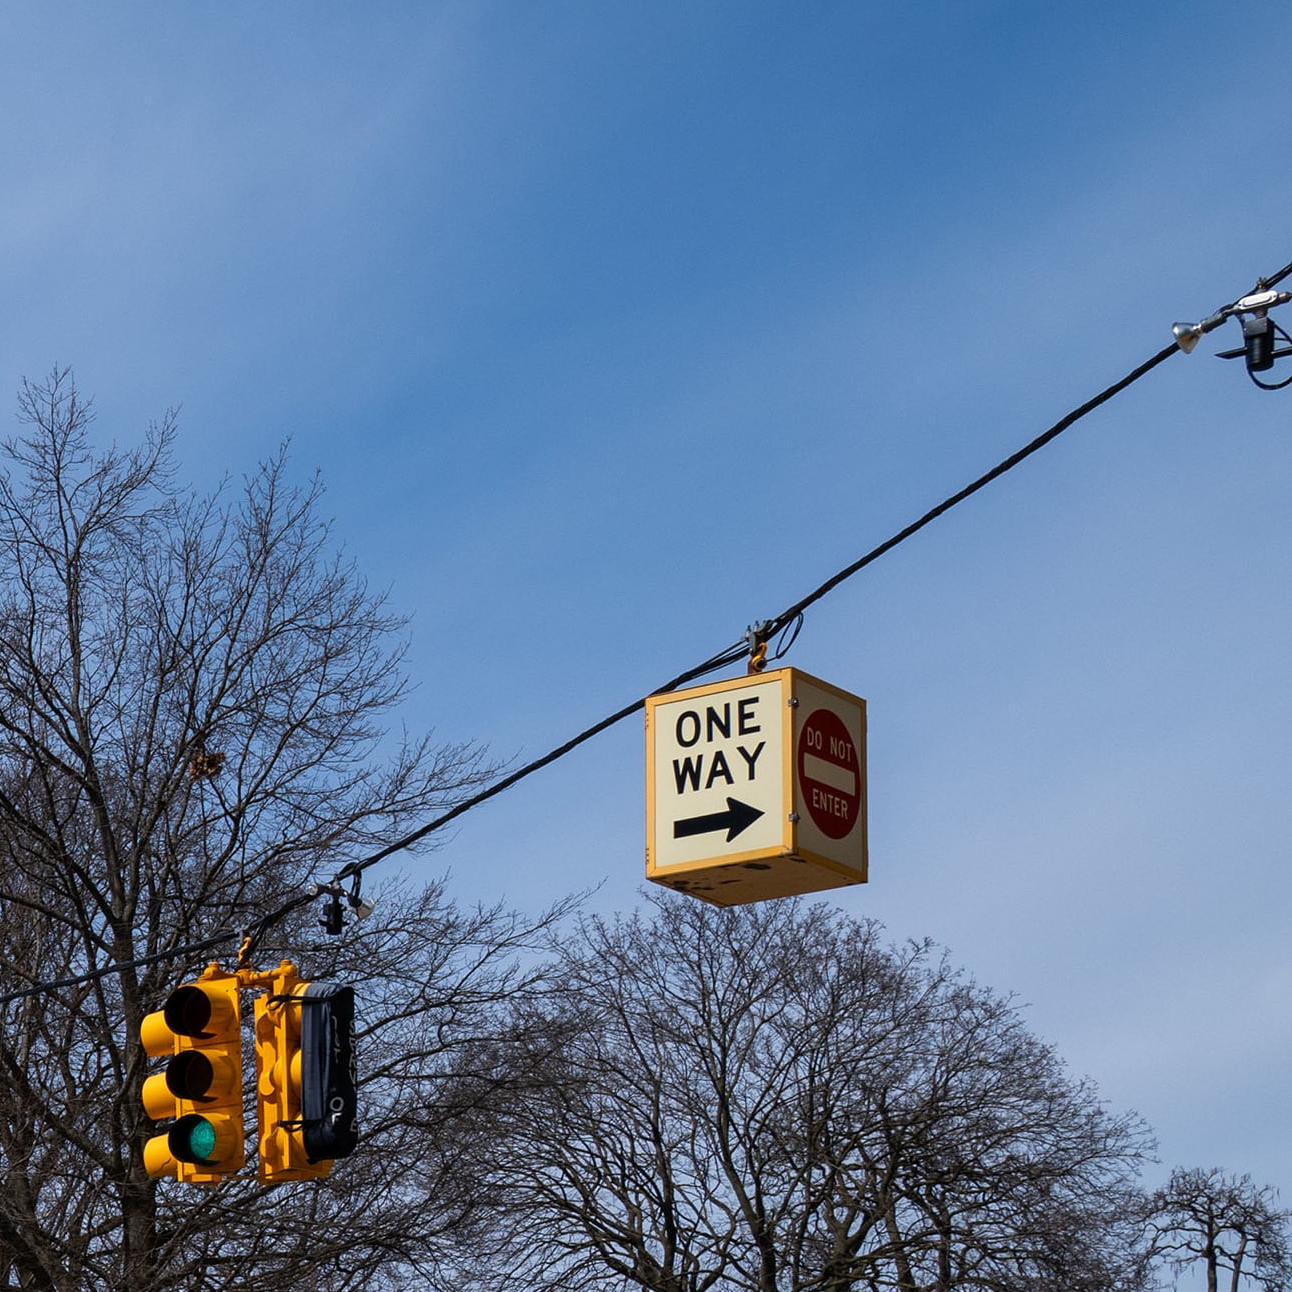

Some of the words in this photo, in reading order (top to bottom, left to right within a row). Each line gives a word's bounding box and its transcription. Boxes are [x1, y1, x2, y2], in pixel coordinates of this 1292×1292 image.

[675, 696, 761, 748] ONE
[807, 726, 823, 750] DO
[830, 736, 852, 762] NOT
[672, 741, 766, 795] WAY
[812, 788, 848, 820] ENTER
